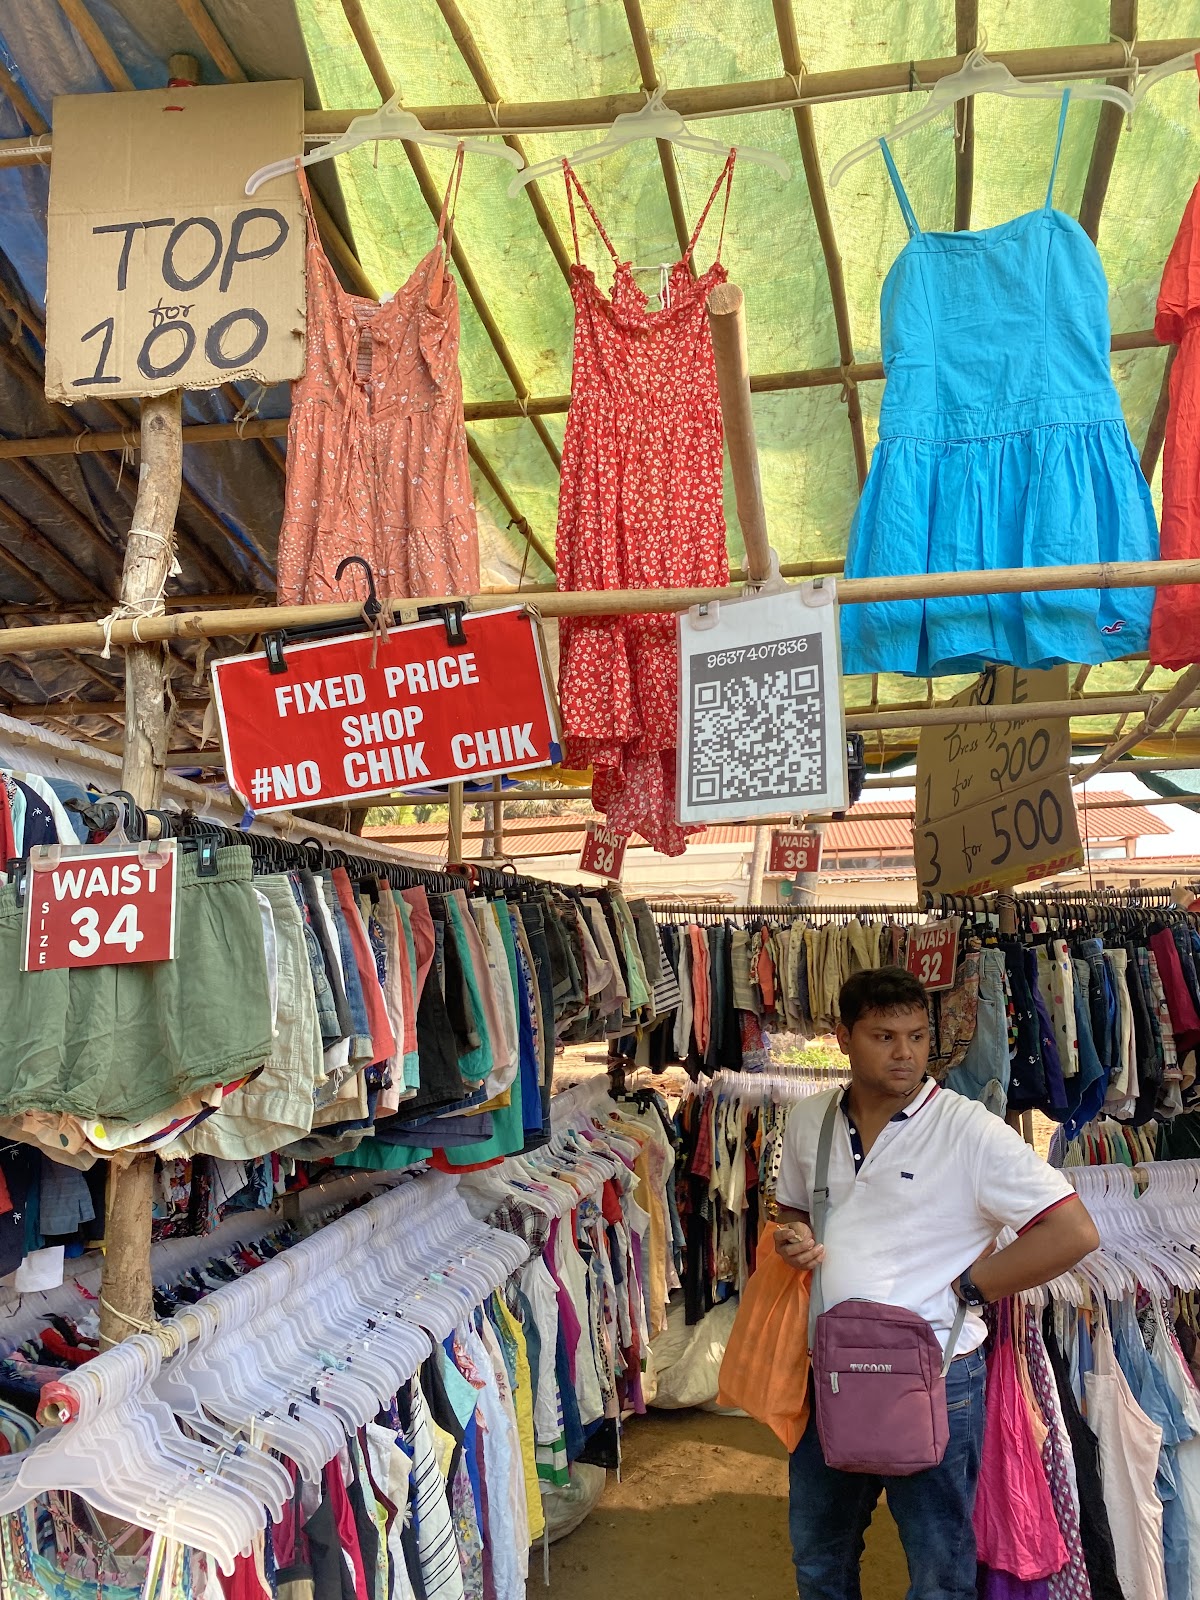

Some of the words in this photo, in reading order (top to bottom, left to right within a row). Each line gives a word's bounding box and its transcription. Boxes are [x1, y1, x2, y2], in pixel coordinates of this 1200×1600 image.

[93, 208, 290, 293] TOP
[149, 297, 196, 328] for
[70, 308, 269, 387] 100
[707, 638, 808, 669] 9637407836
[274, 673, 366, 718] FIXED
[384, 652, 480, 699] PRICE
[341, 705, 424, 748] SHOP
[250, 760, 322, 804] #NO
[343, 741, 431, 788] CHIK
[450, 722, 539, 770] CHIK
[948, 734, 978, 763] Dress
[922, 773, 932, 825] 1
[951, 768, 974, 807] for
[990, 728, 1050, 793] 200
[594, 827, 625, 849] WAIST
[779, 835, 816, 849] WAIST
[922, 832, 941, 888] 3
[961, 824, 983, 874] for
[990, 788, 1063, 866] 500
[593, 847, 615, 873] 36
[783, 849, 808, 869] 38
[52, 864, 159, 901] WAIST
[38, 902, 50, 964] SIZE
[68, 903, 145, 958] 34
[916, 928, 953, 952] WAIST
[918, 951, 943, 983] 32
[850, 1363, 892, 1373] TYCOON
